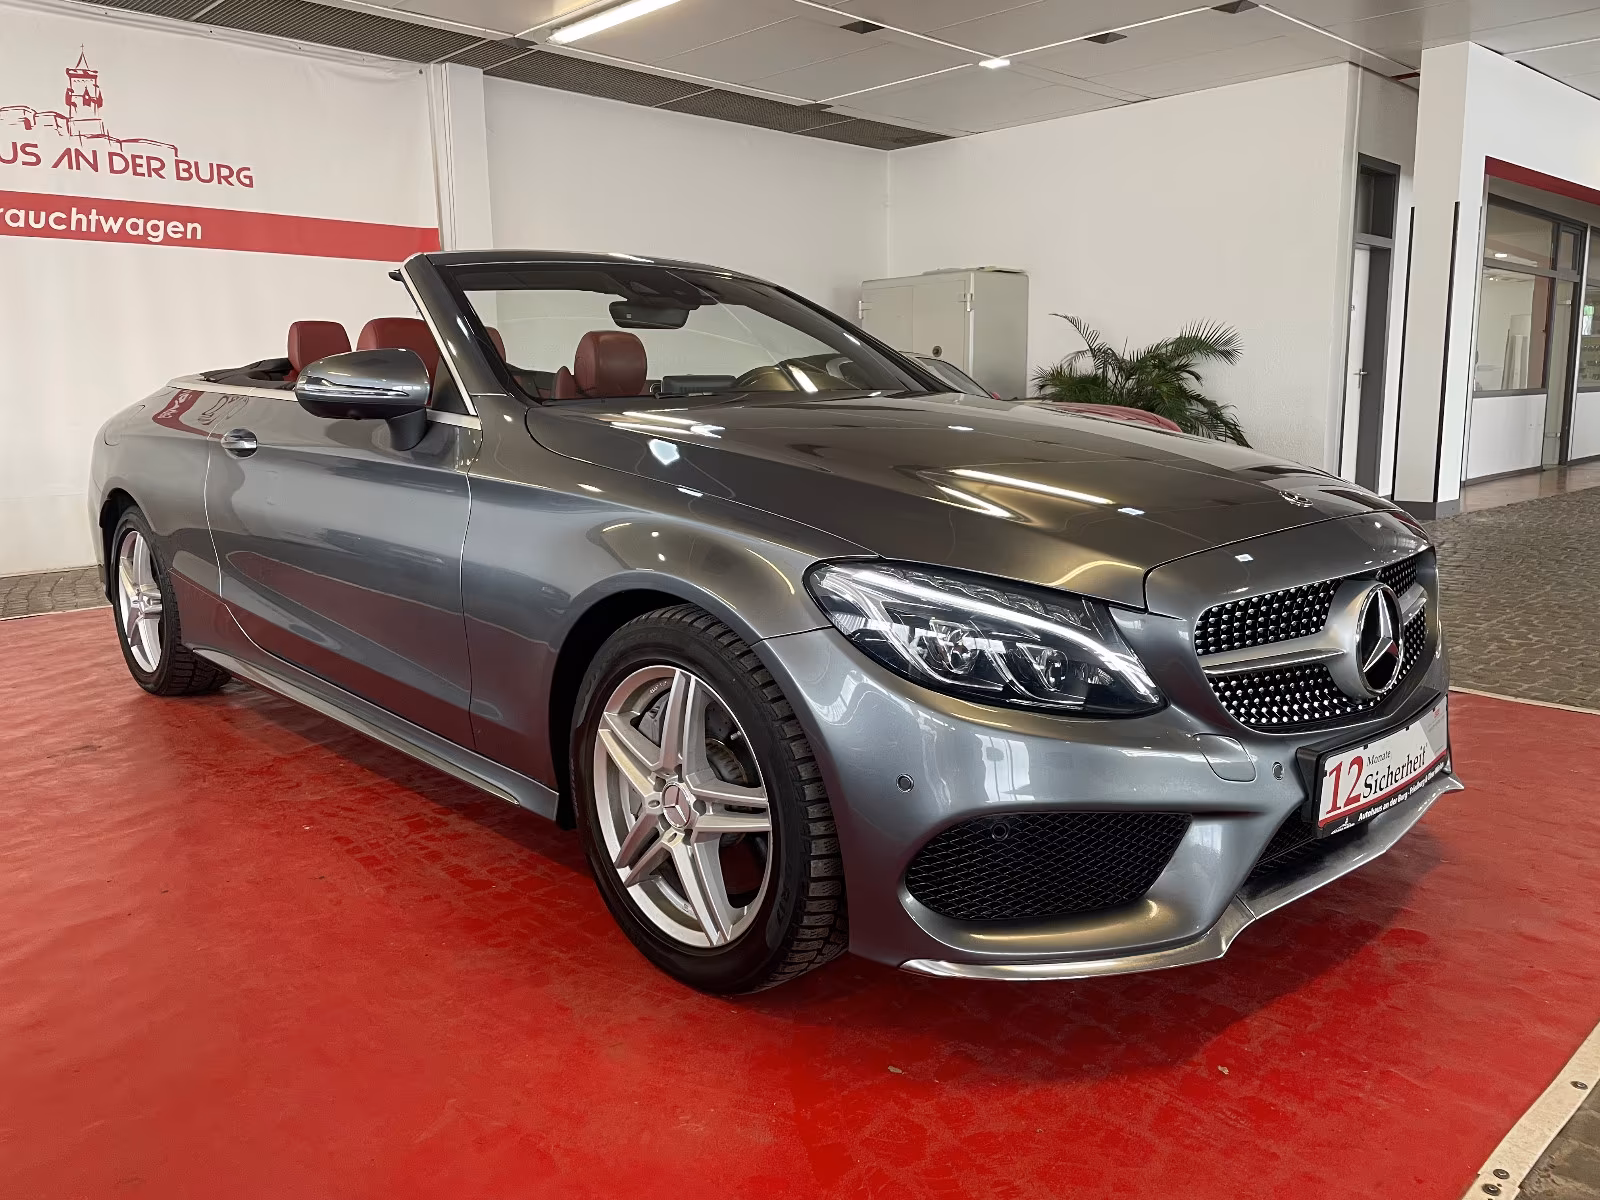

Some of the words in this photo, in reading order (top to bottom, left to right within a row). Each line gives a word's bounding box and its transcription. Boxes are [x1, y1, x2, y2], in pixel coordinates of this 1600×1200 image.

[51, 147, 99, 173] AN
[108, 151, 166, 180] DER
[175, 159, 254, 188] BURG
[1366, 750, 1391, 767] Monate
[1325, 756, 1364, 815] 12
[1362, 745, 1426, 799] Sicherheit
[1358, 805, 1382, 821] Autohaus
[1382, 802, 1390, 810] an
[1389, 797, 1397, 807] der
